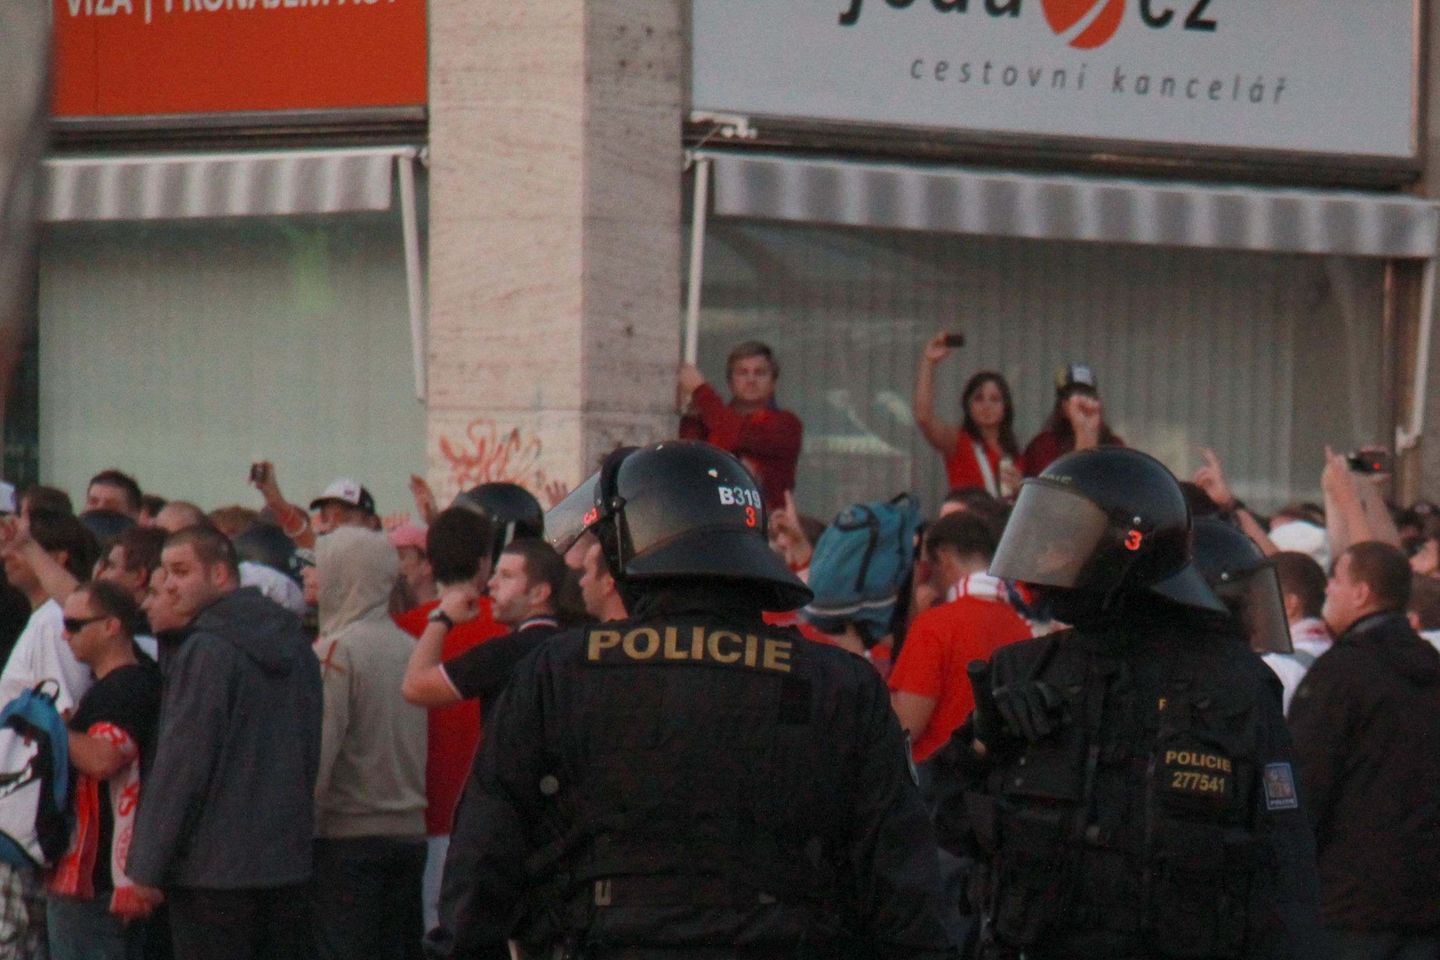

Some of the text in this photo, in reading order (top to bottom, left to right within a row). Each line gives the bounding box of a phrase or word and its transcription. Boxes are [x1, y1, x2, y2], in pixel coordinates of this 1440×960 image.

[910, 58, 1287, 103] cestovní kancelář
[718, 486, 761, 509] B319
[745, 506, 757, 529] 3
[1124, 530, 1142, 550] 3
[587, 626, 793, 672] POLICIE
[1165, 751, 1233, 773] POLICIE
[1172, 771, 1225, 793] 277541
